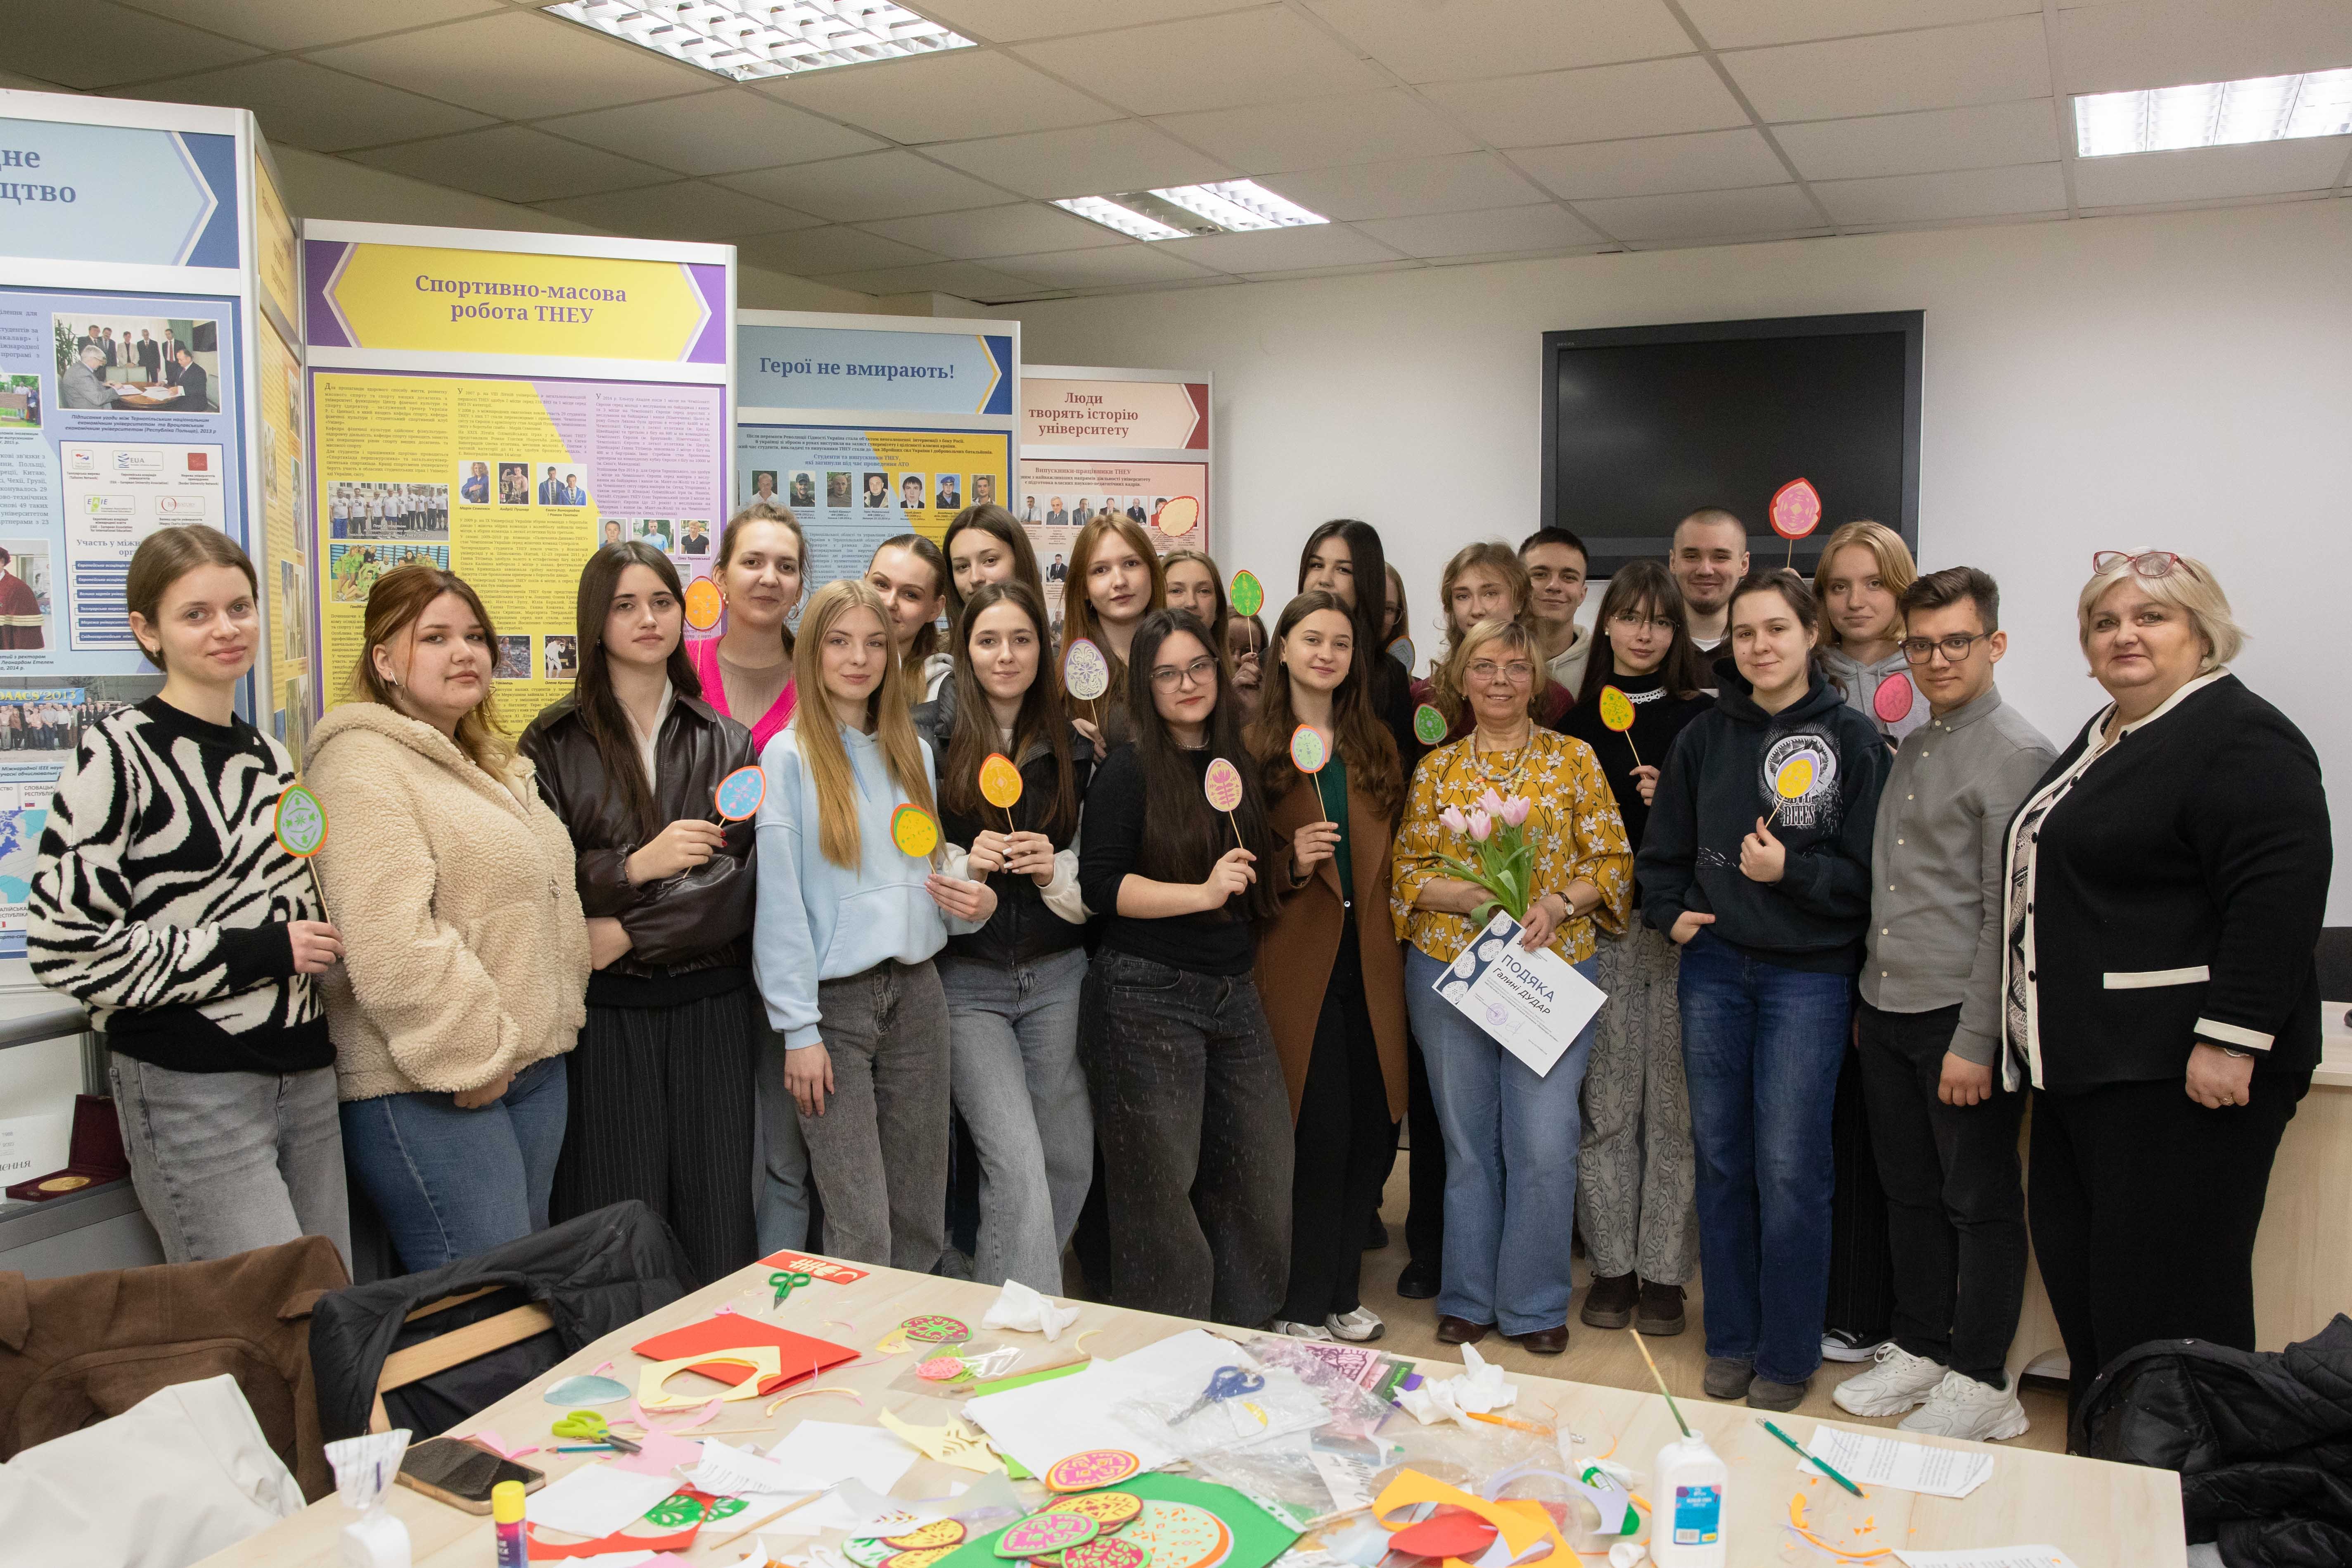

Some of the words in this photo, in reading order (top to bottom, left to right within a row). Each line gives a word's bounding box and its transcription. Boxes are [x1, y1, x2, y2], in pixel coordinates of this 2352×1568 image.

[0, 150, 40, 171] не
[0, 183, 76, 205] цтво
[415, 275, 626, 303] Спортивно-масова
[451, 302, 528, 322] робота
[535, 306, 594, 323] ТНЕУ
[760, 358, 811, 377] Герої
[817, 363, 840, 375] не
[846, 364, 953, 381] вмирають!
[1065, 392, 1103, 406] Люди
[1029, 410, 1084, 421] творять
[1088, 408, 1138, 422] історію
[1038, 423, 1129, 439] університету
[1784, 804, 1815, 826] BITES
[1501, 954, 1554, 1002] ПОДЯКА
[1493, 968, 1521, 991] Галині
[1517, 990, 1550, 1014] ДУДАР
